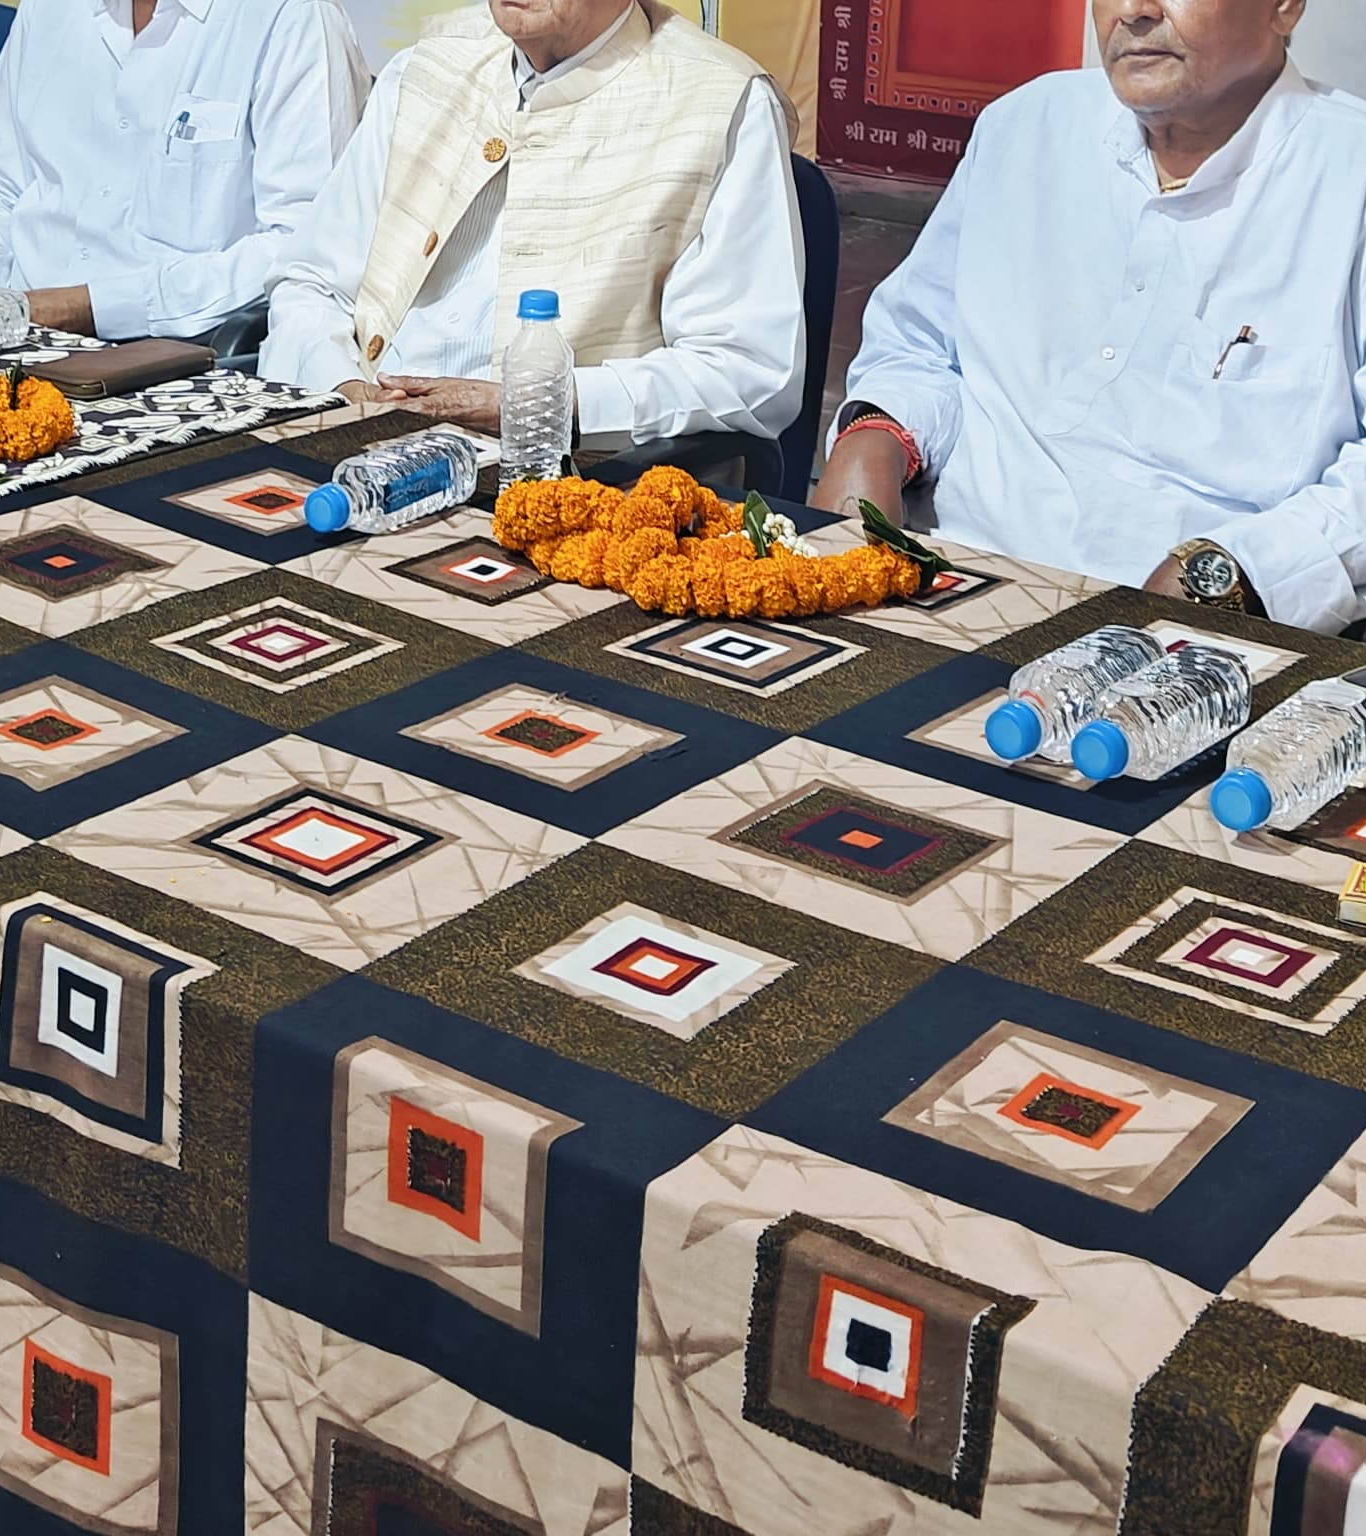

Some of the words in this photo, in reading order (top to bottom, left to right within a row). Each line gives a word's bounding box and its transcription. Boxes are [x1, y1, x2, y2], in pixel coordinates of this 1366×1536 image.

[845, 120, 865, 142] श्री
[868, 126, 898, 147] राम
[906, 129, 928, 151] श्री
[931, 135, 962, 156] राम
